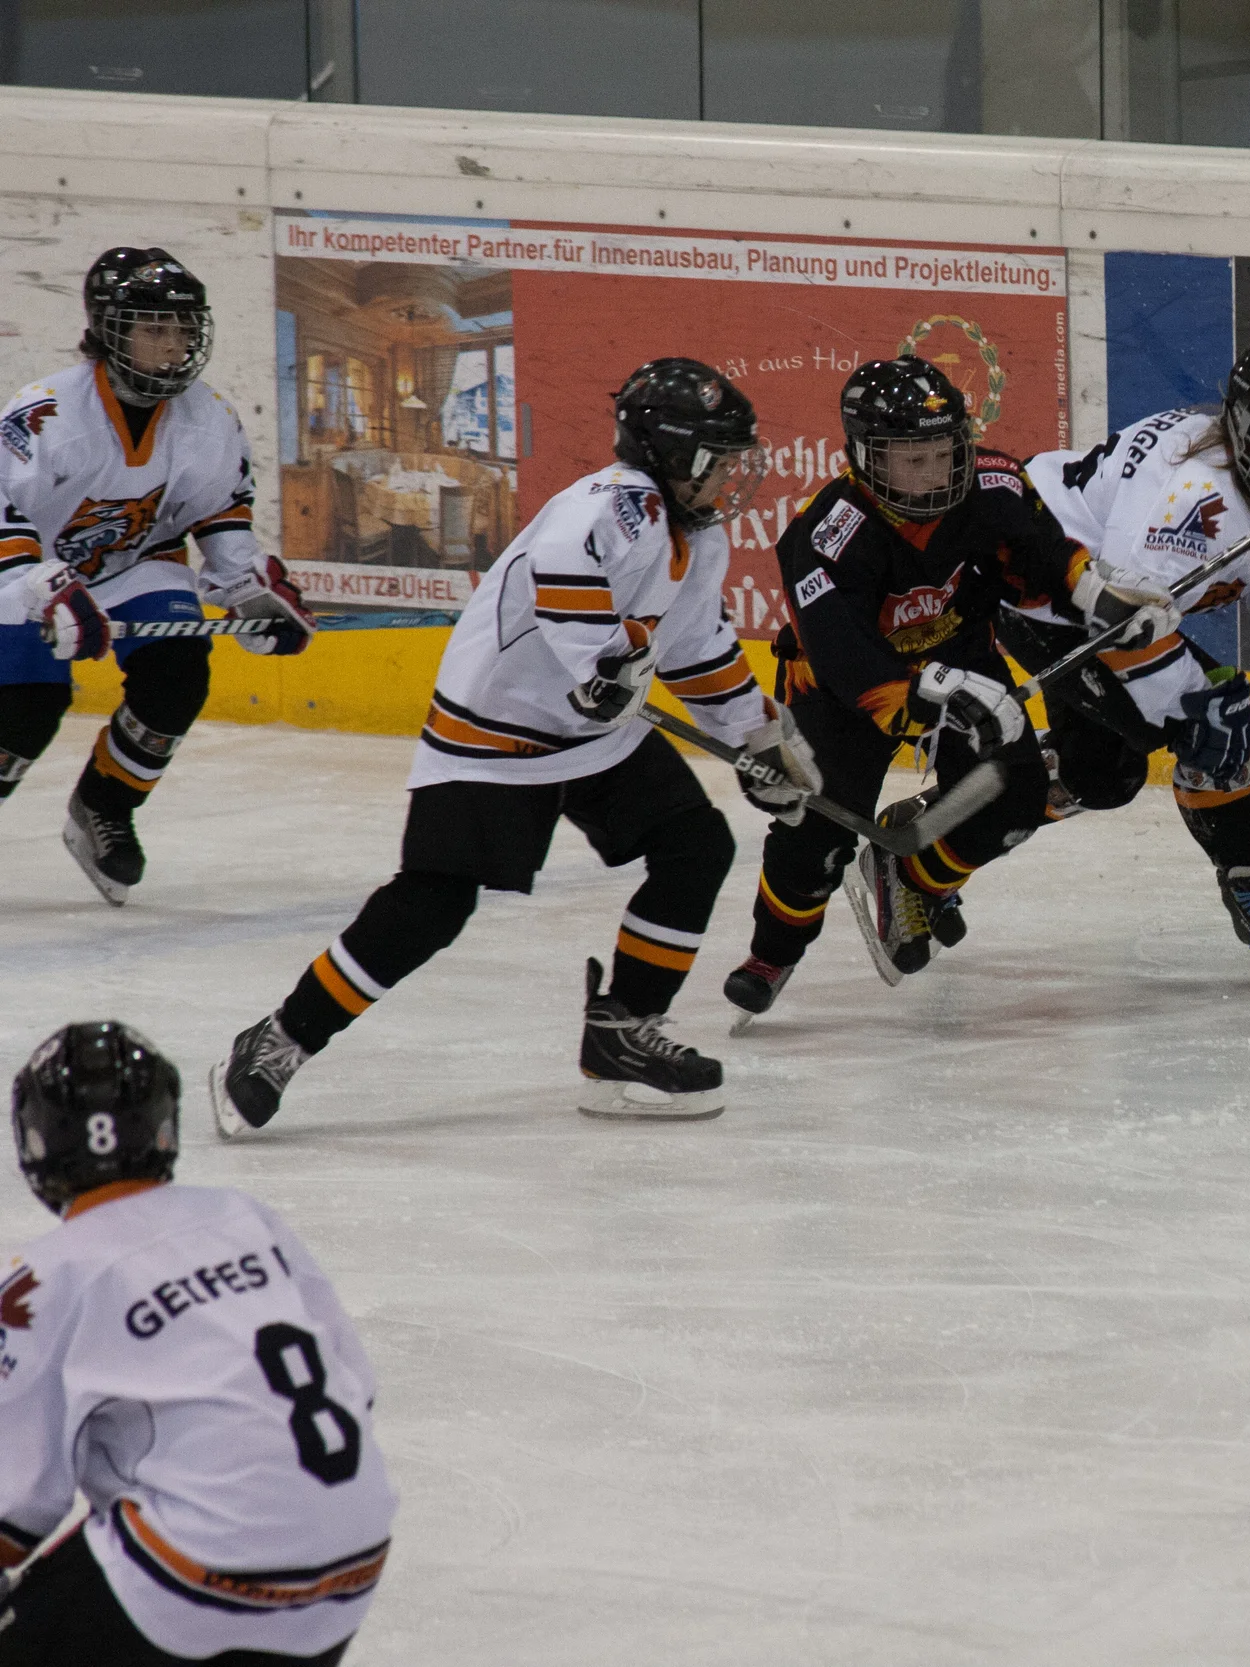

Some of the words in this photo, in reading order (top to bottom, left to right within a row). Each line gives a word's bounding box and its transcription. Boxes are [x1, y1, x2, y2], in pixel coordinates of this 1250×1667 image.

[288, 224, 315, 247] Ihr
[322, 226, 461, 257] kompetenter
[467, 234, 548, 260] Partner
[553, 238, 585, 263] für
[592, 240, 740, 274] Innenausbau,
[746, 248, 838, 282] Planung
[845, 258, 887, 279] und
[895, 256, 1057, 292] Projektleitung.
[758, 356, 804, 372] aus
[813, 346, 862, 372] Hol
[919, 413, 953, 427] Reebok
[1146, 533, 1209, 554] OKANAG
[338, 573, 459, 601] KITZBÜHEL
[131, 617, 286, 637] ARRIO
[86, 1112, 118, 1156] 8
[254, 1321, 361, 1489] 8
